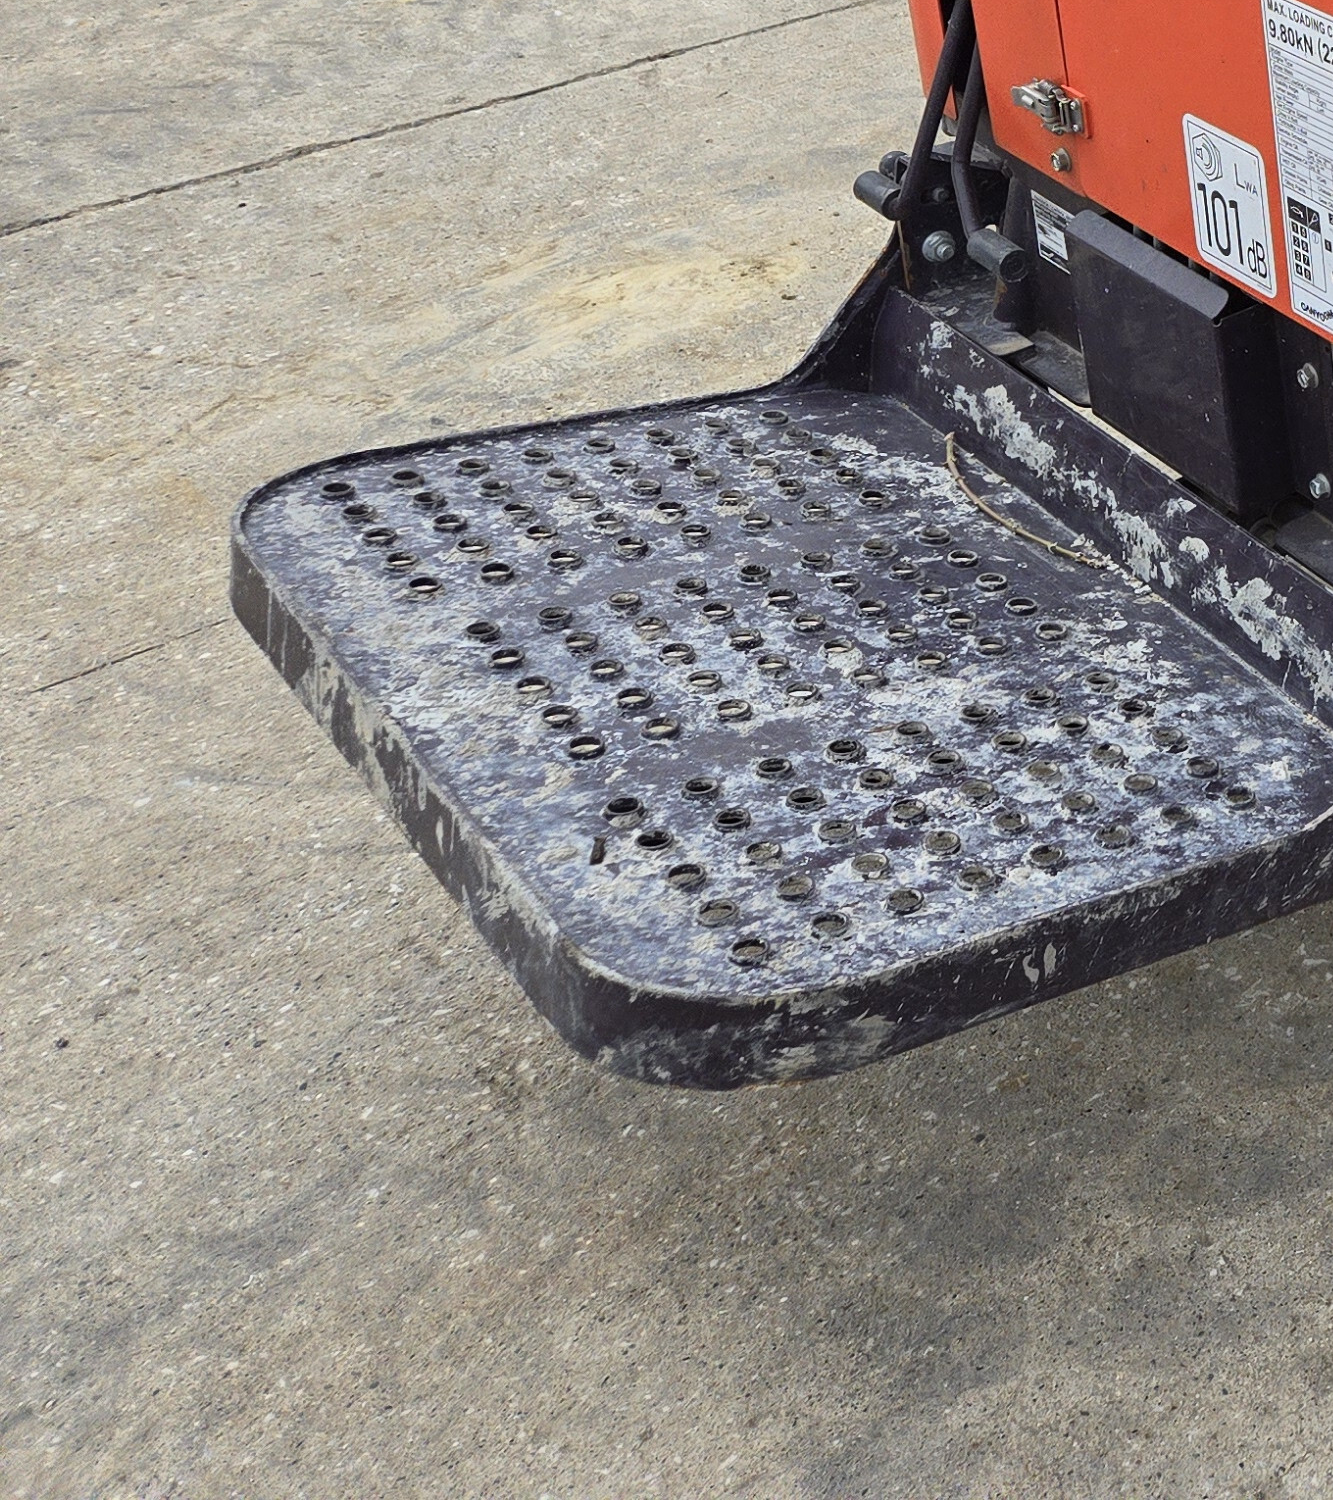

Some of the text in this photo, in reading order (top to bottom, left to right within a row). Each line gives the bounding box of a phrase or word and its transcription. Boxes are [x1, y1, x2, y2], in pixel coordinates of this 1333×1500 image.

[1268, 18, 1313, 56] 9.80kN
[1288, 7, 1326, 35] LOADING
[1197, 182, 1268, 279] 101 dB
